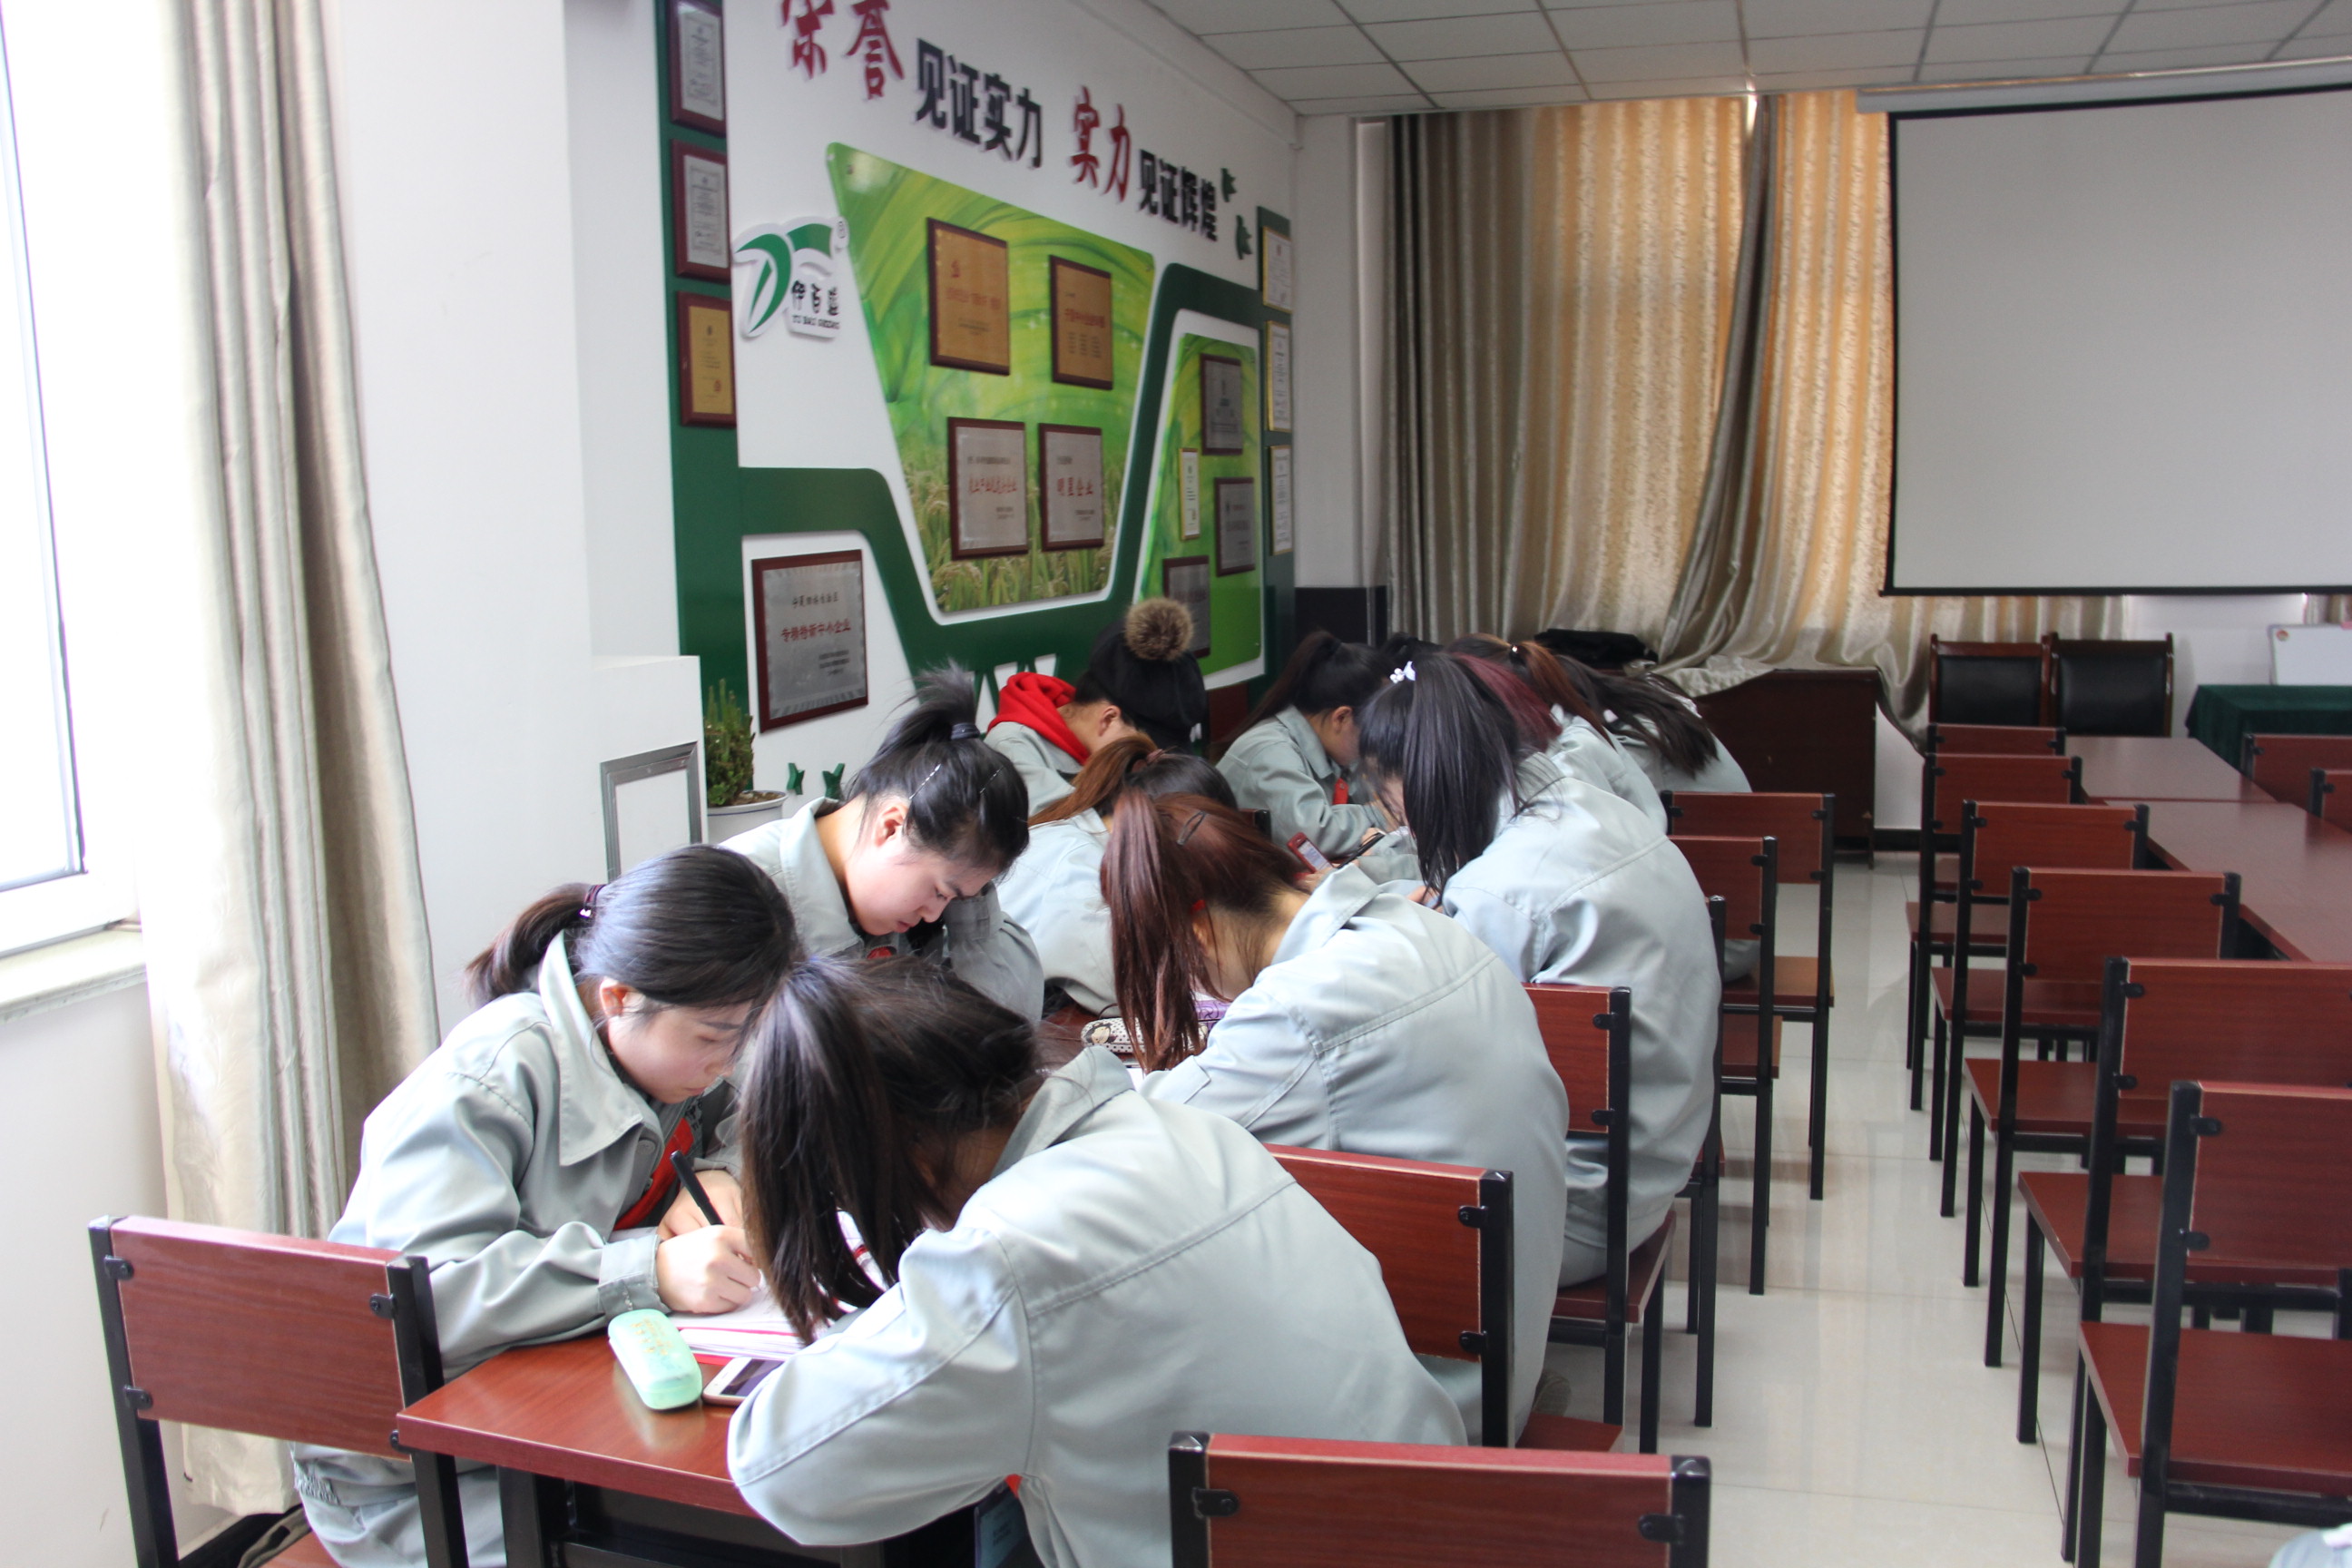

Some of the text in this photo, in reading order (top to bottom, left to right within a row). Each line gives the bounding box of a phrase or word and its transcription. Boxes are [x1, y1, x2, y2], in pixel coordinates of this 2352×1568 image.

[915, 37, 1042, 169] 见证实力
[1070, 85, 1132, 202] 实力
[1139, 149, 1218, 241] 见证辉煌
